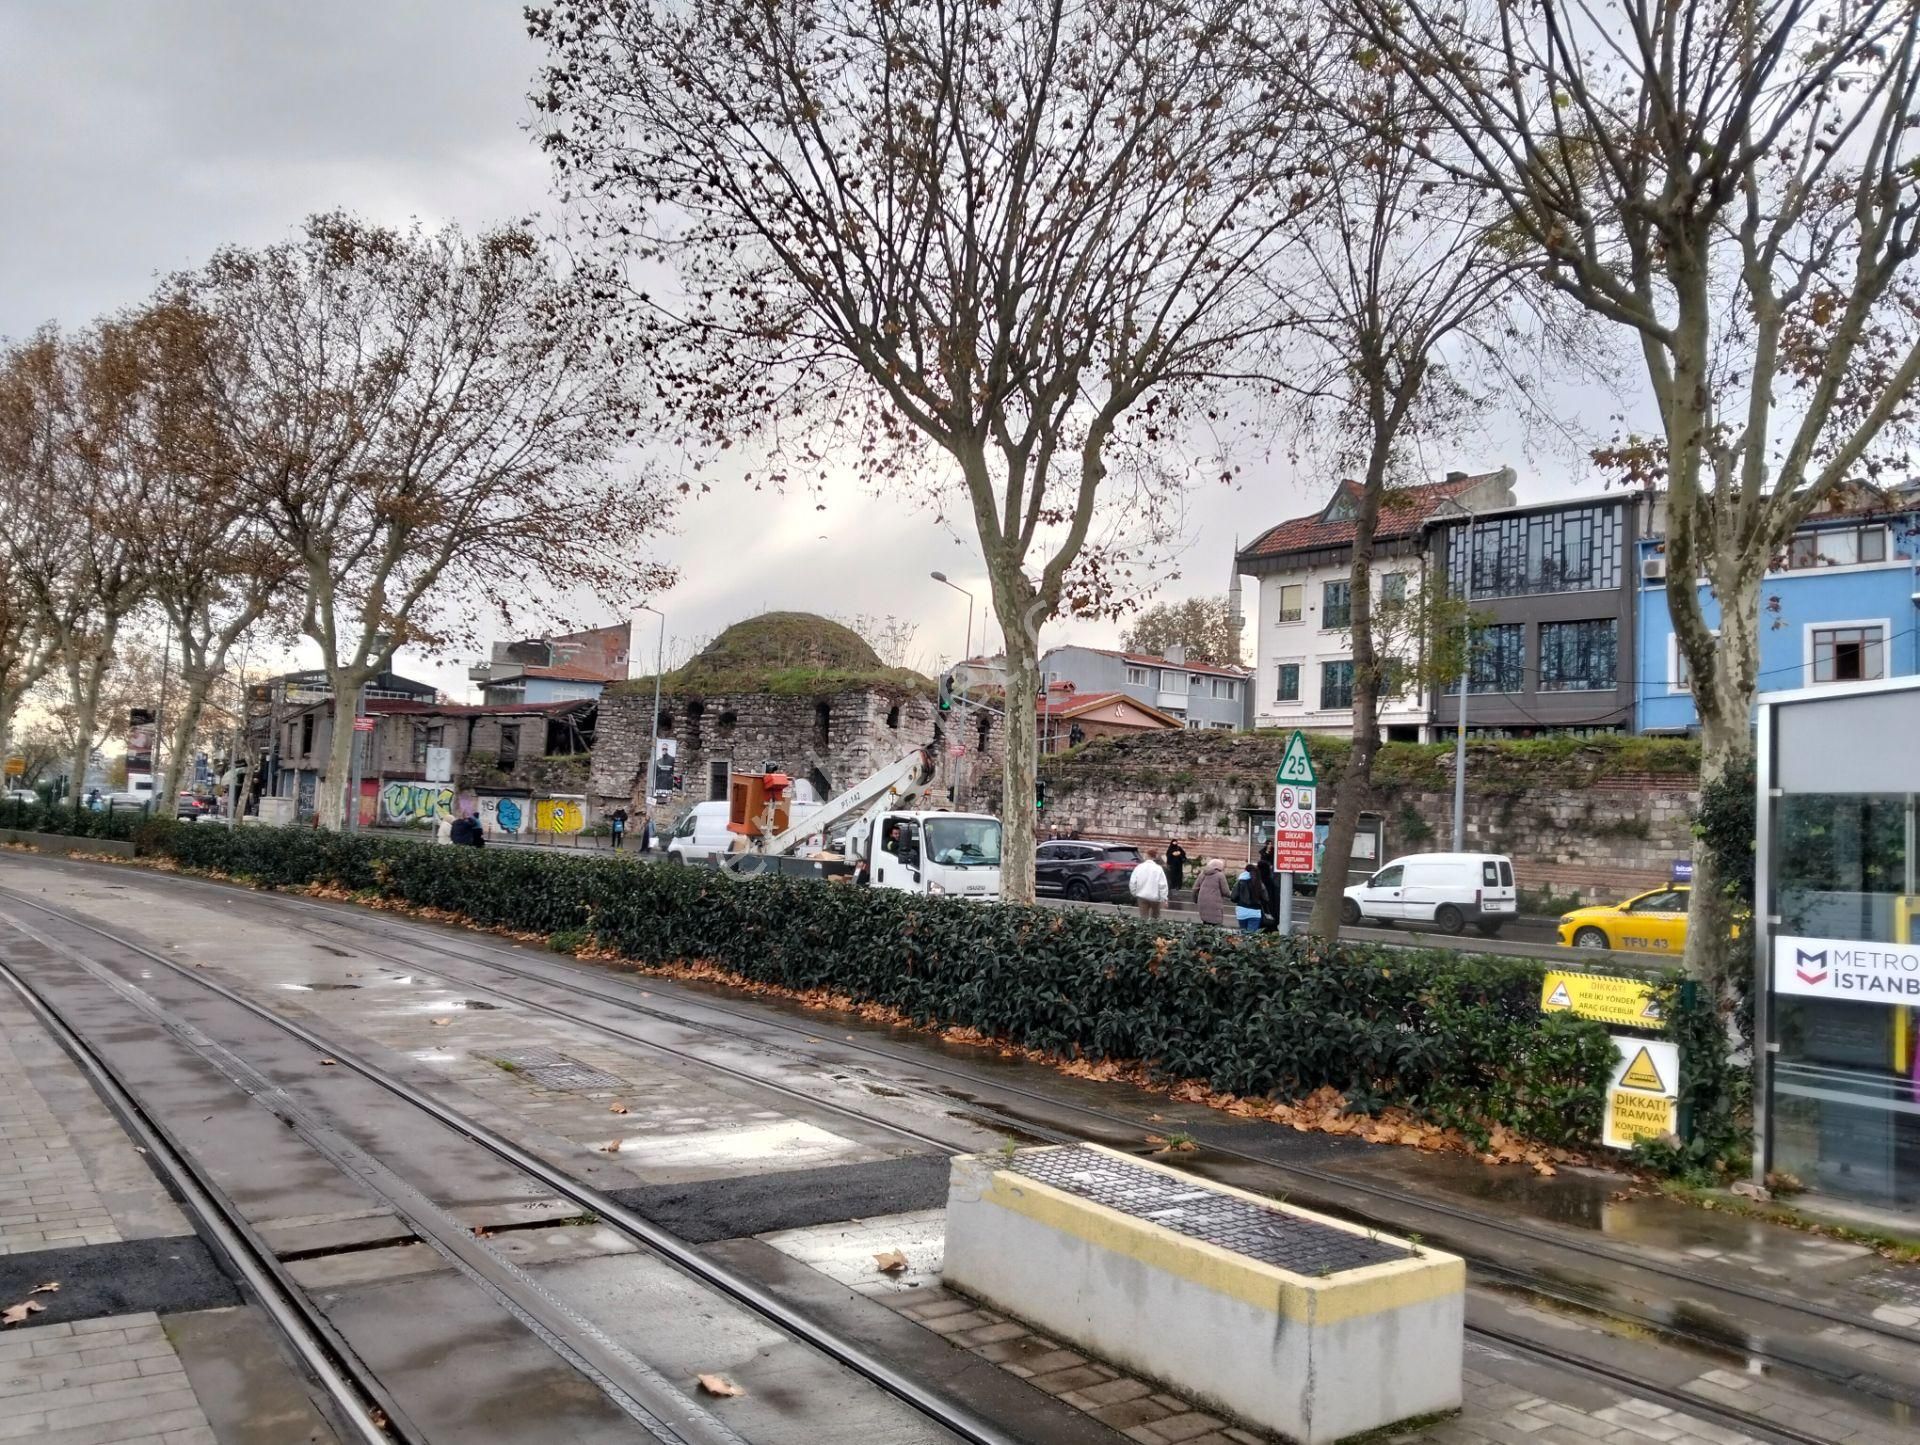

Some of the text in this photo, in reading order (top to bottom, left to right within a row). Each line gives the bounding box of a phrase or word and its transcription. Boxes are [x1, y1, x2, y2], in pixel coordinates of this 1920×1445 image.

[1288, 755, 1306, 775] 25
[1622, 937, 1669, 949] TFU 43
[1834, 950, 1919, 972] METRO
[1578, 1002, 1599, 1012] ARAÇ
[1579, 991, 1593, 1000] HER
[1606, 995, 1636, 1005] YÖNDEN
[1616, 1093, 1666, 1111] DİKKAT!
[1614, 1105, 1668, 1123] TRAMVAY
